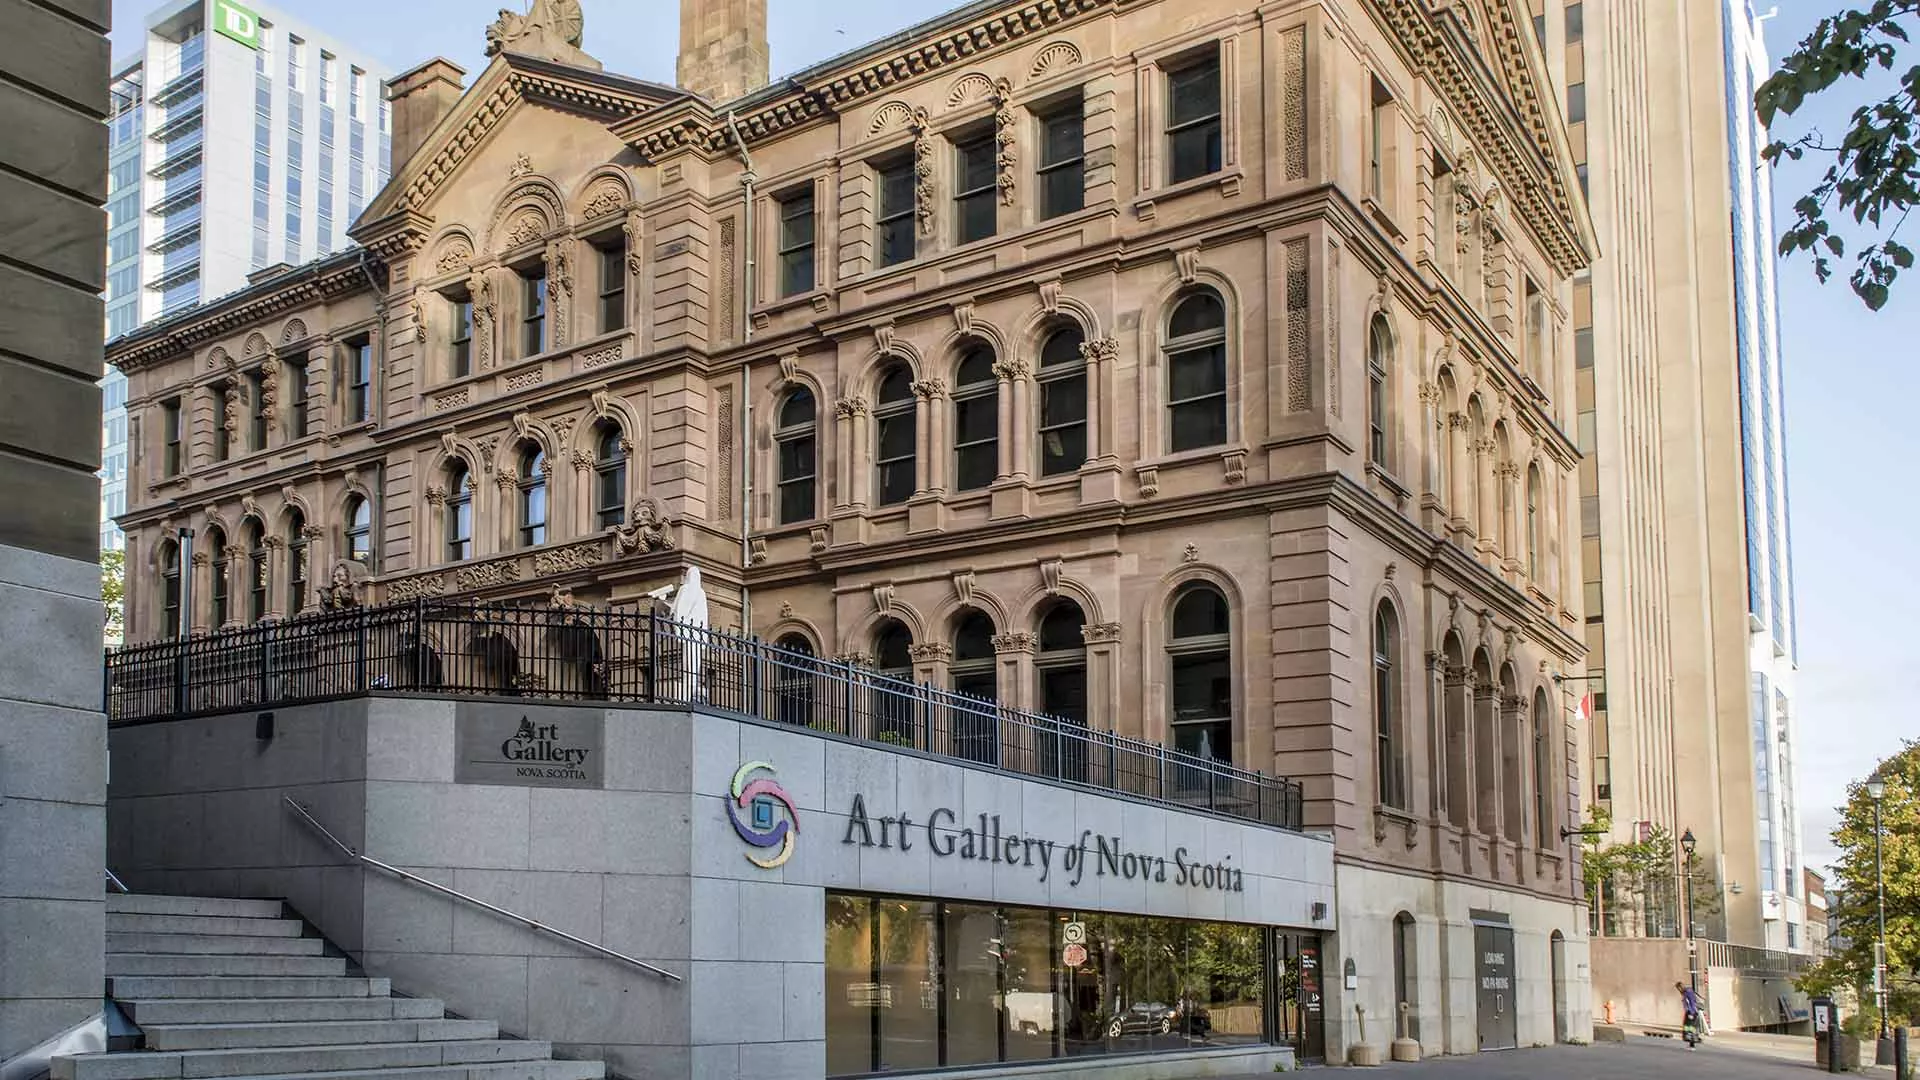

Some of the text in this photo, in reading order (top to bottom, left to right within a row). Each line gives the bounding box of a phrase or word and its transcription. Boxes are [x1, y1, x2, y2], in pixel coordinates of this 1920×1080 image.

[219, 2, 255, 38] TD
[513, 714, 559, 743] Art
[502, 738, 590, 764] Gallery
[516, 767, 586, 780] NOVA SCOTIA
[842, 793, 1244, 892] Art Gallery of Nova Scotia
